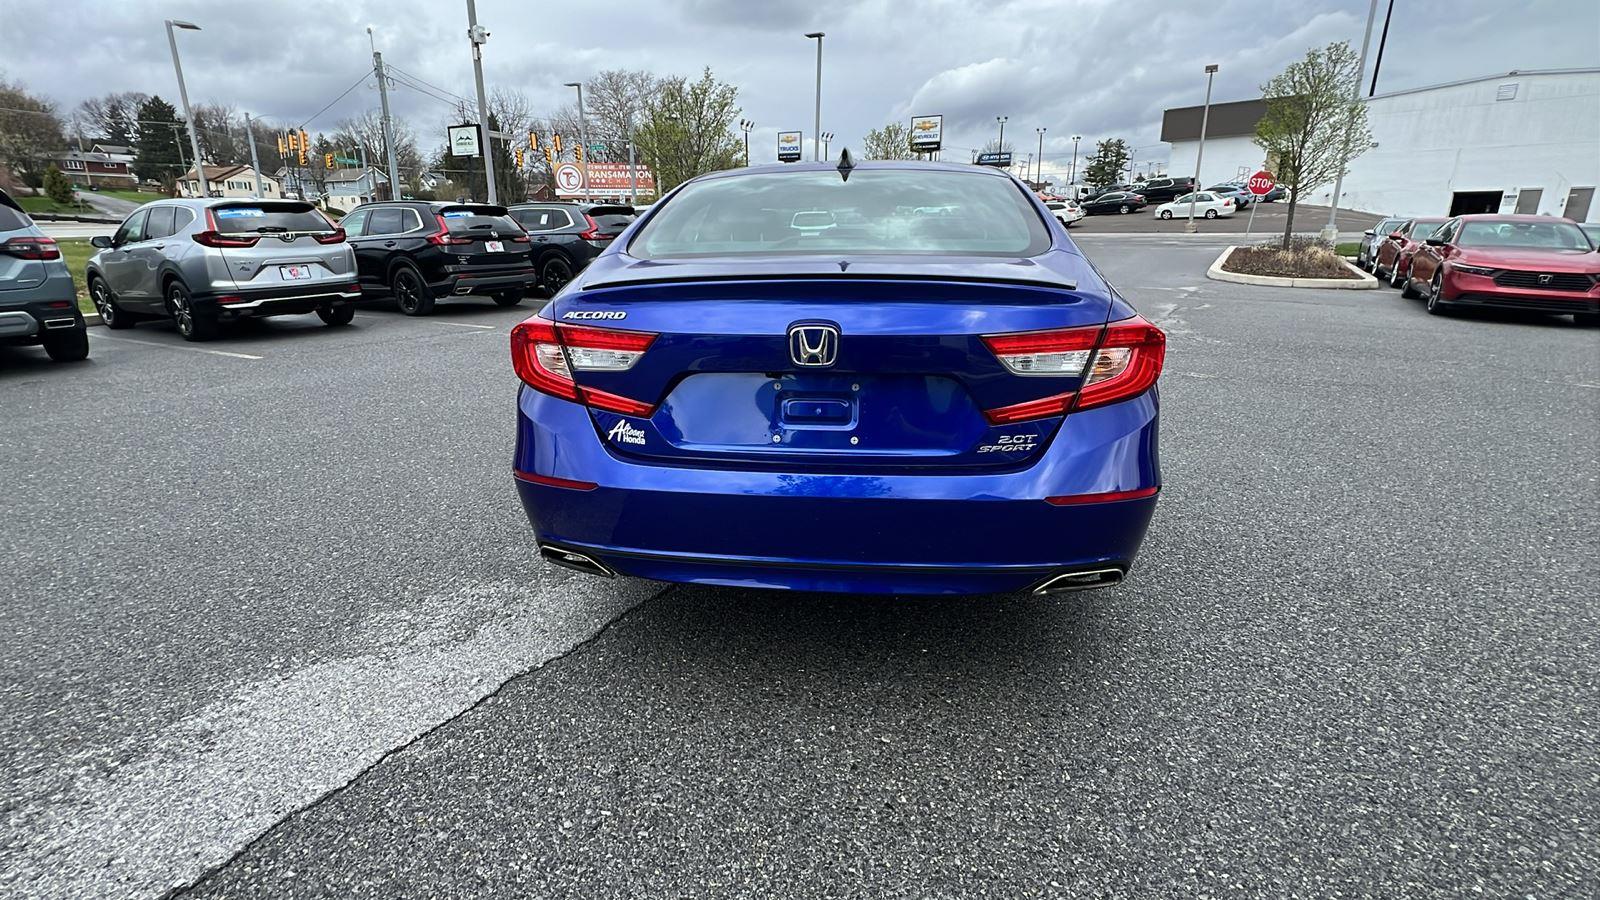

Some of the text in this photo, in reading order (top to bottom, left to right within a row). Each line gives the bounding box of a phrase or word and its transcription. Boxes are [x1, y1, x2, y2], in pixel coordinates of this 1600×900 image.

[587, 170, 652, 179] RANS4MAION
[562, 311, 627, 320] ACCORD
[607, 419, 645, 442] Altoona
[623, 435, 646, 445] Honda
[977, 443, 1037, 453] SPORT
